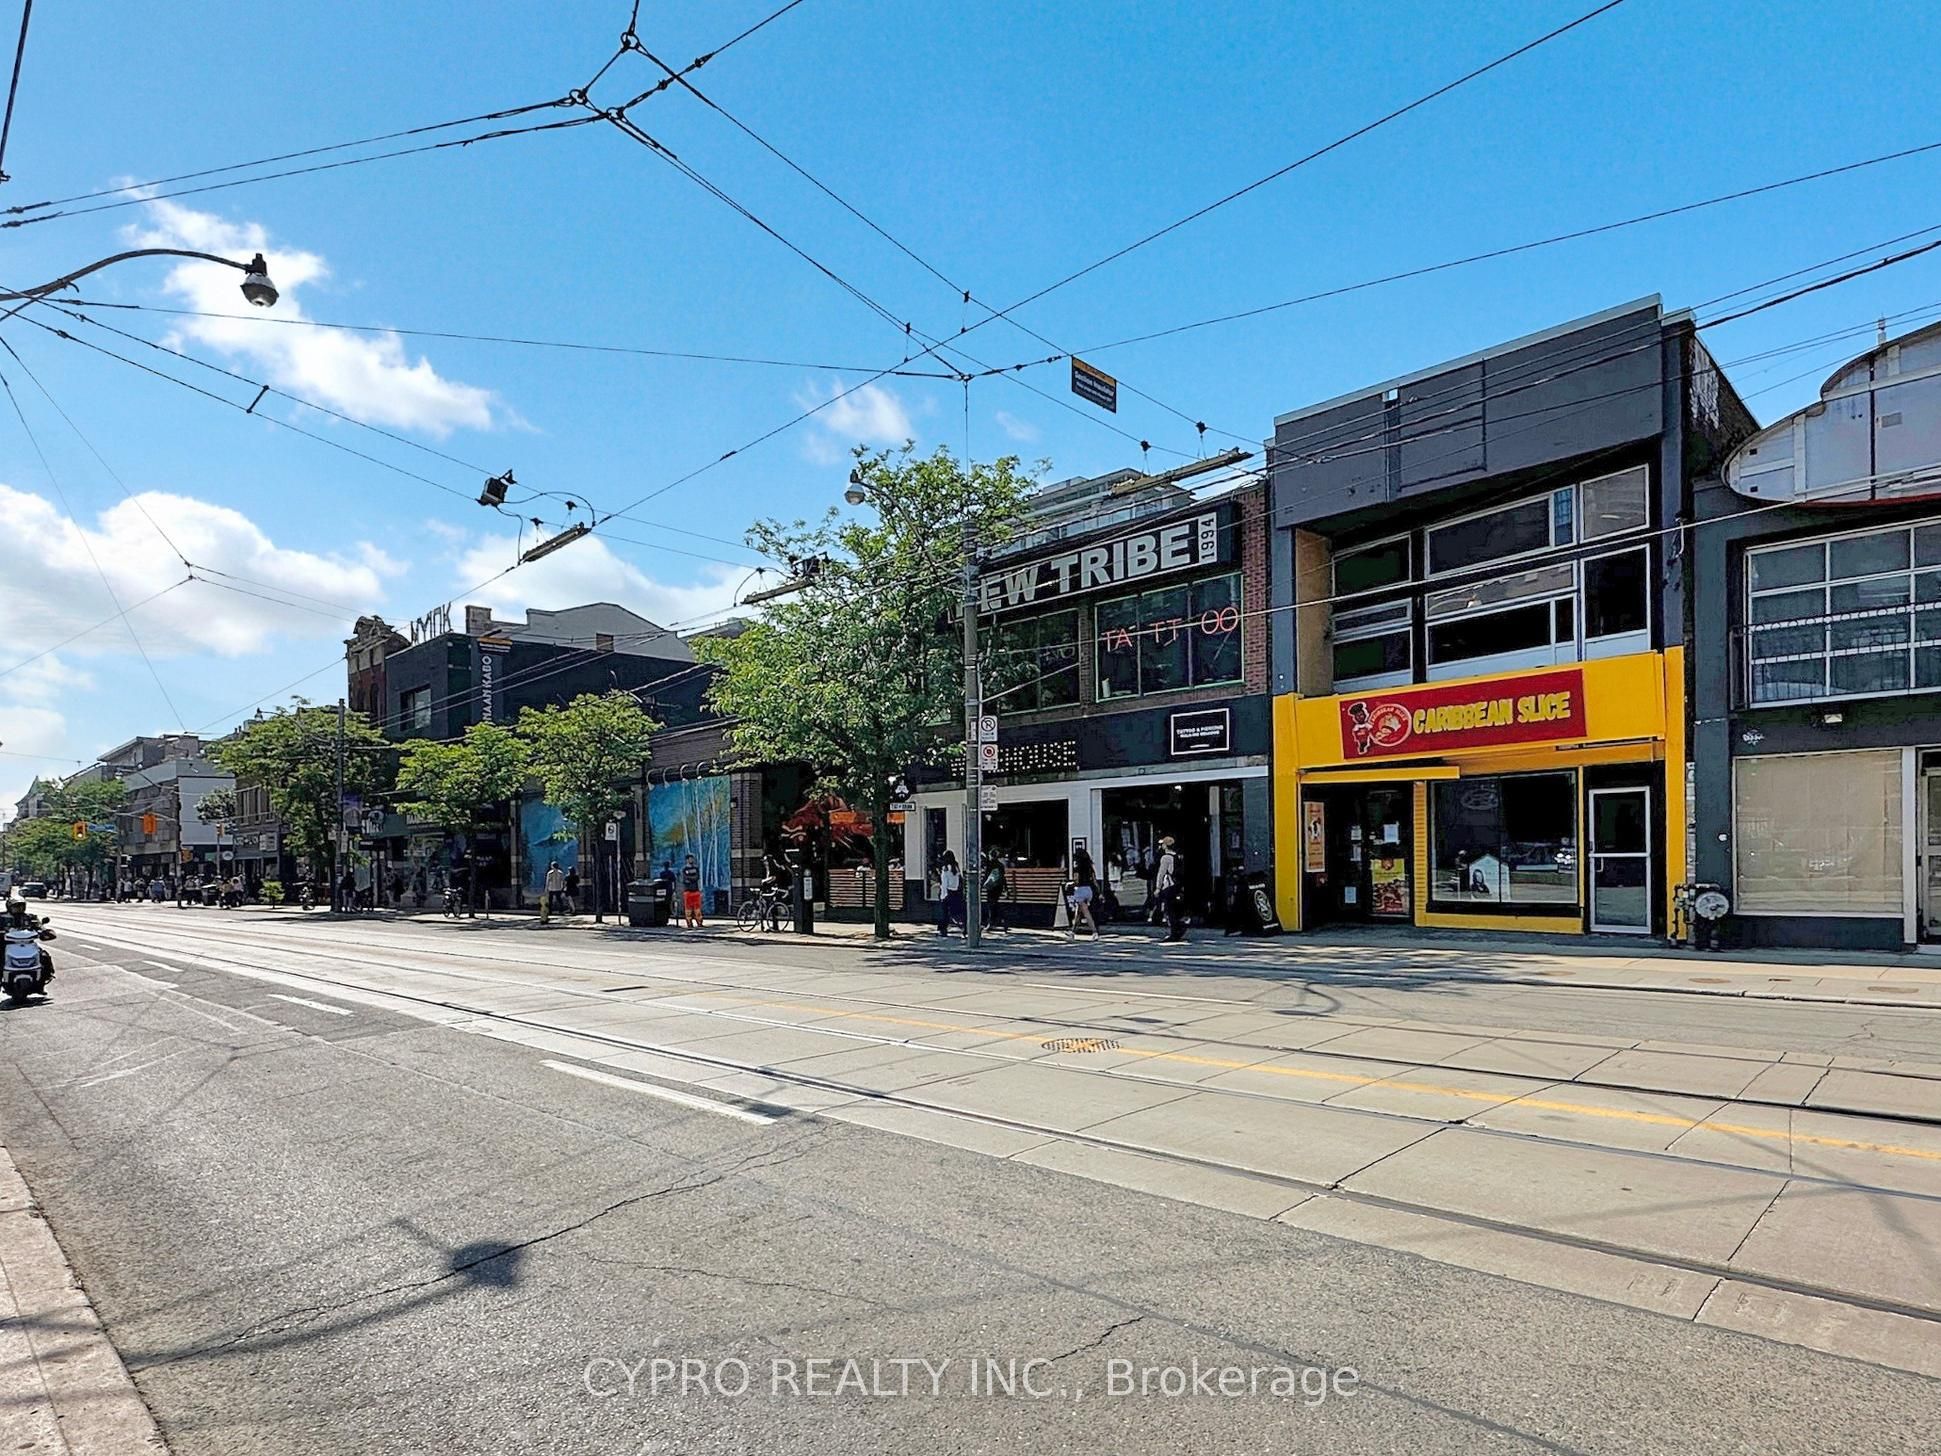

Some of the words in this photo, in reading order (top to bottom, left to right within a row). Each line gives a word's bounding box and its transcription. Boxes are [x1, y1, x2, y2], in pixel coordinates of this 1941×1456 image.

[1051, 524, 1191, 593] TRIBE
[1201, 518, 1215, 559] 1994
[1413, 698, 1514, 734] CARIBBEAN
[1517, 691, 1571, 722] SLICE
